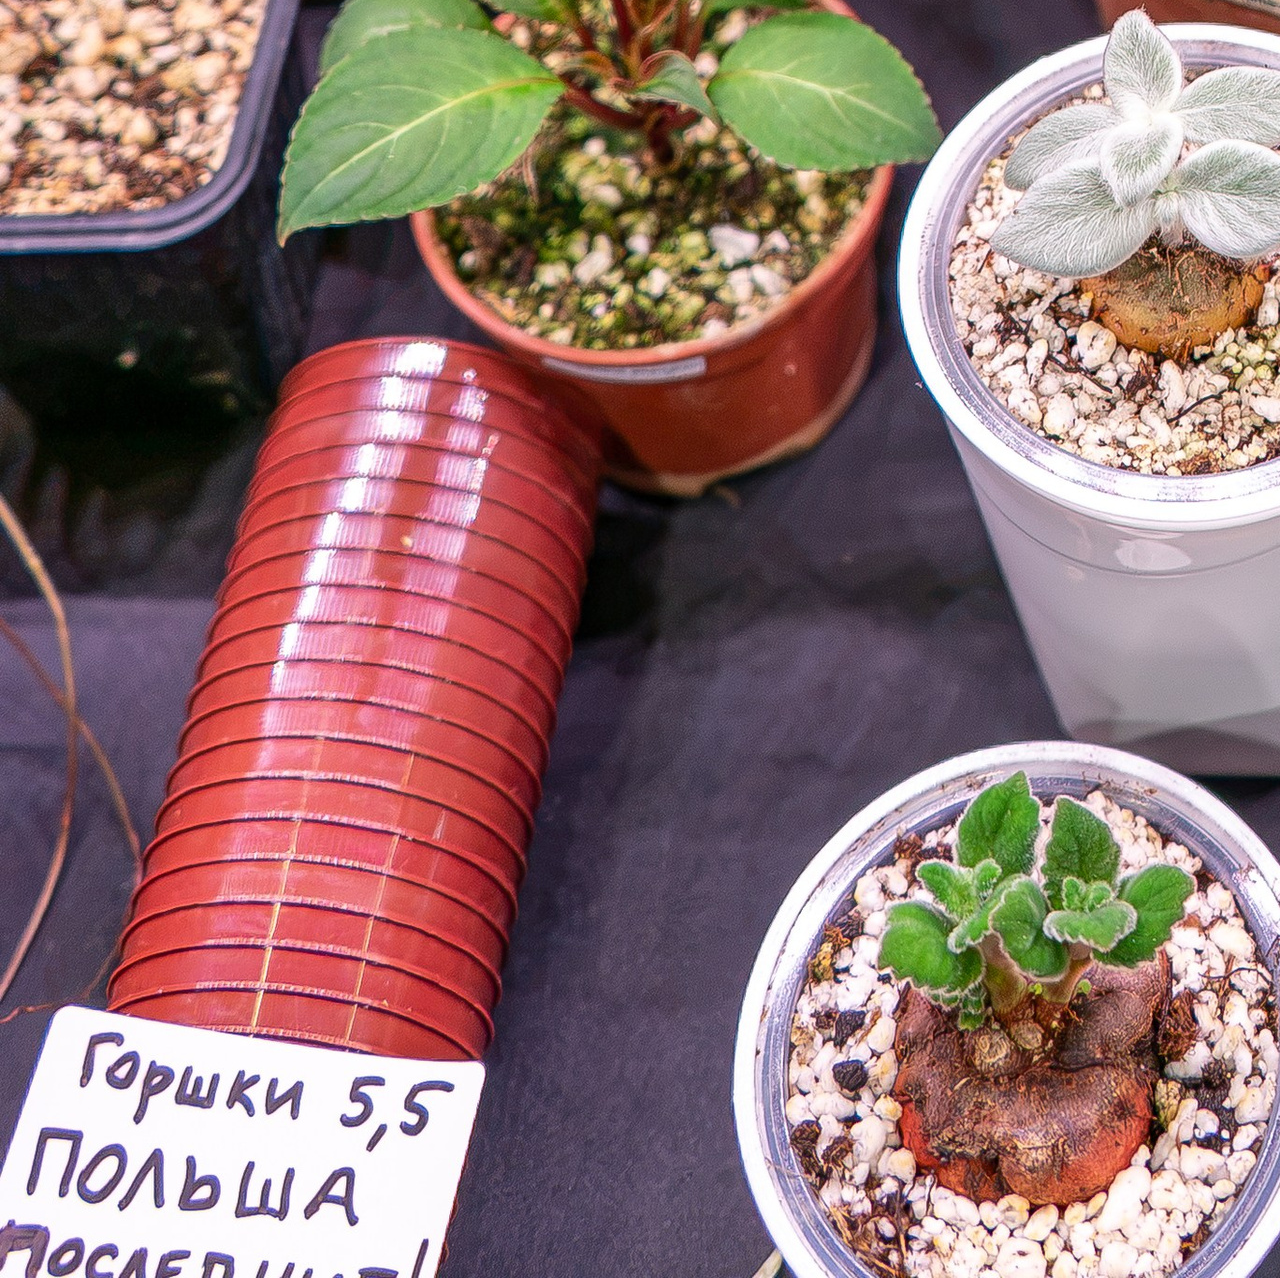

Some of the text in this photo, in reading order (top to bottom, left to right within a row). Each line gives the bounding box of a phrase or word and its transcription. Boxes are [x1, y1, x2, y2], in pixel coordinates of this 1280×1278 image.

[79, 1031, 455, 1152] Горшки 5,5
[26, 1126, 360, 1227] ПОЛЬША
[0, 1219, 430, 1278] ПОСЛЕ!
